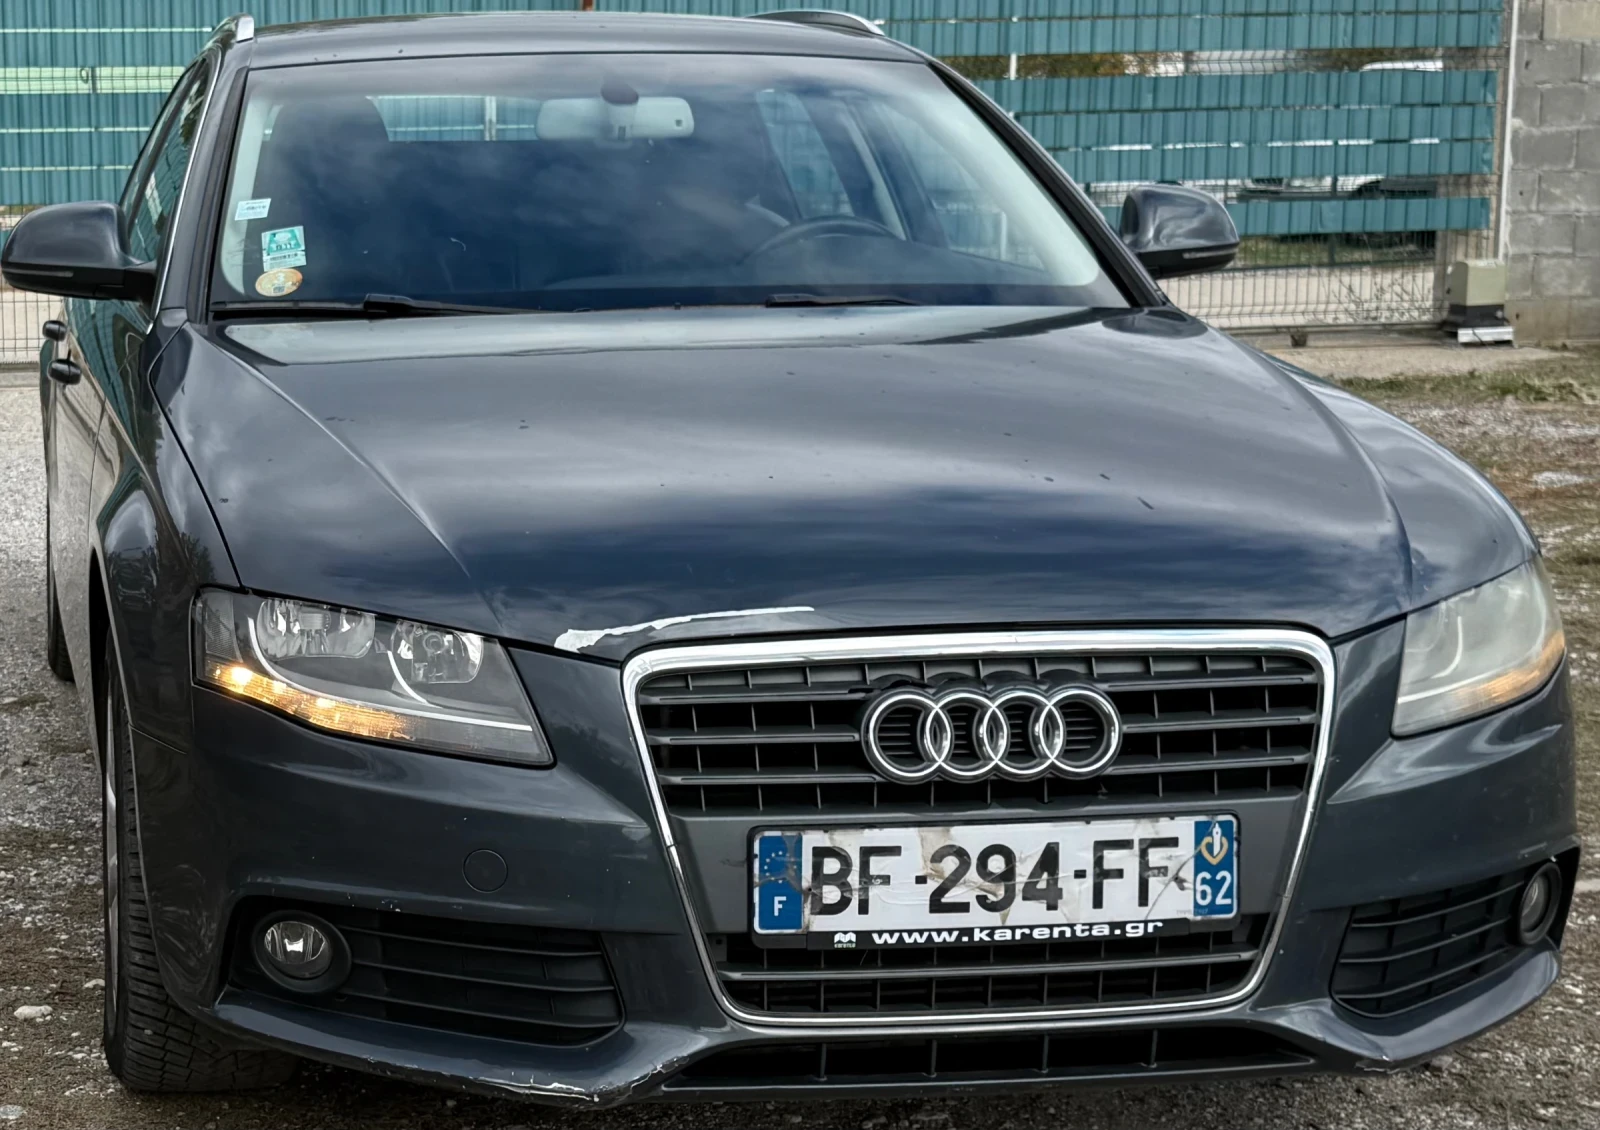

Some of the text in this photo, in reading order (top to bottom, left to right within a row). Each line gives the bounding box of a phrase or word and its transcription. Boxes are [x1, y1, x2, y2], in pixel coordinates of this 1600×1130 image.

[1195, 870, 1232, 906] 62
[773, 896, 787, 916] F
[871, 921, 1164, 945] www.karenta.gr
